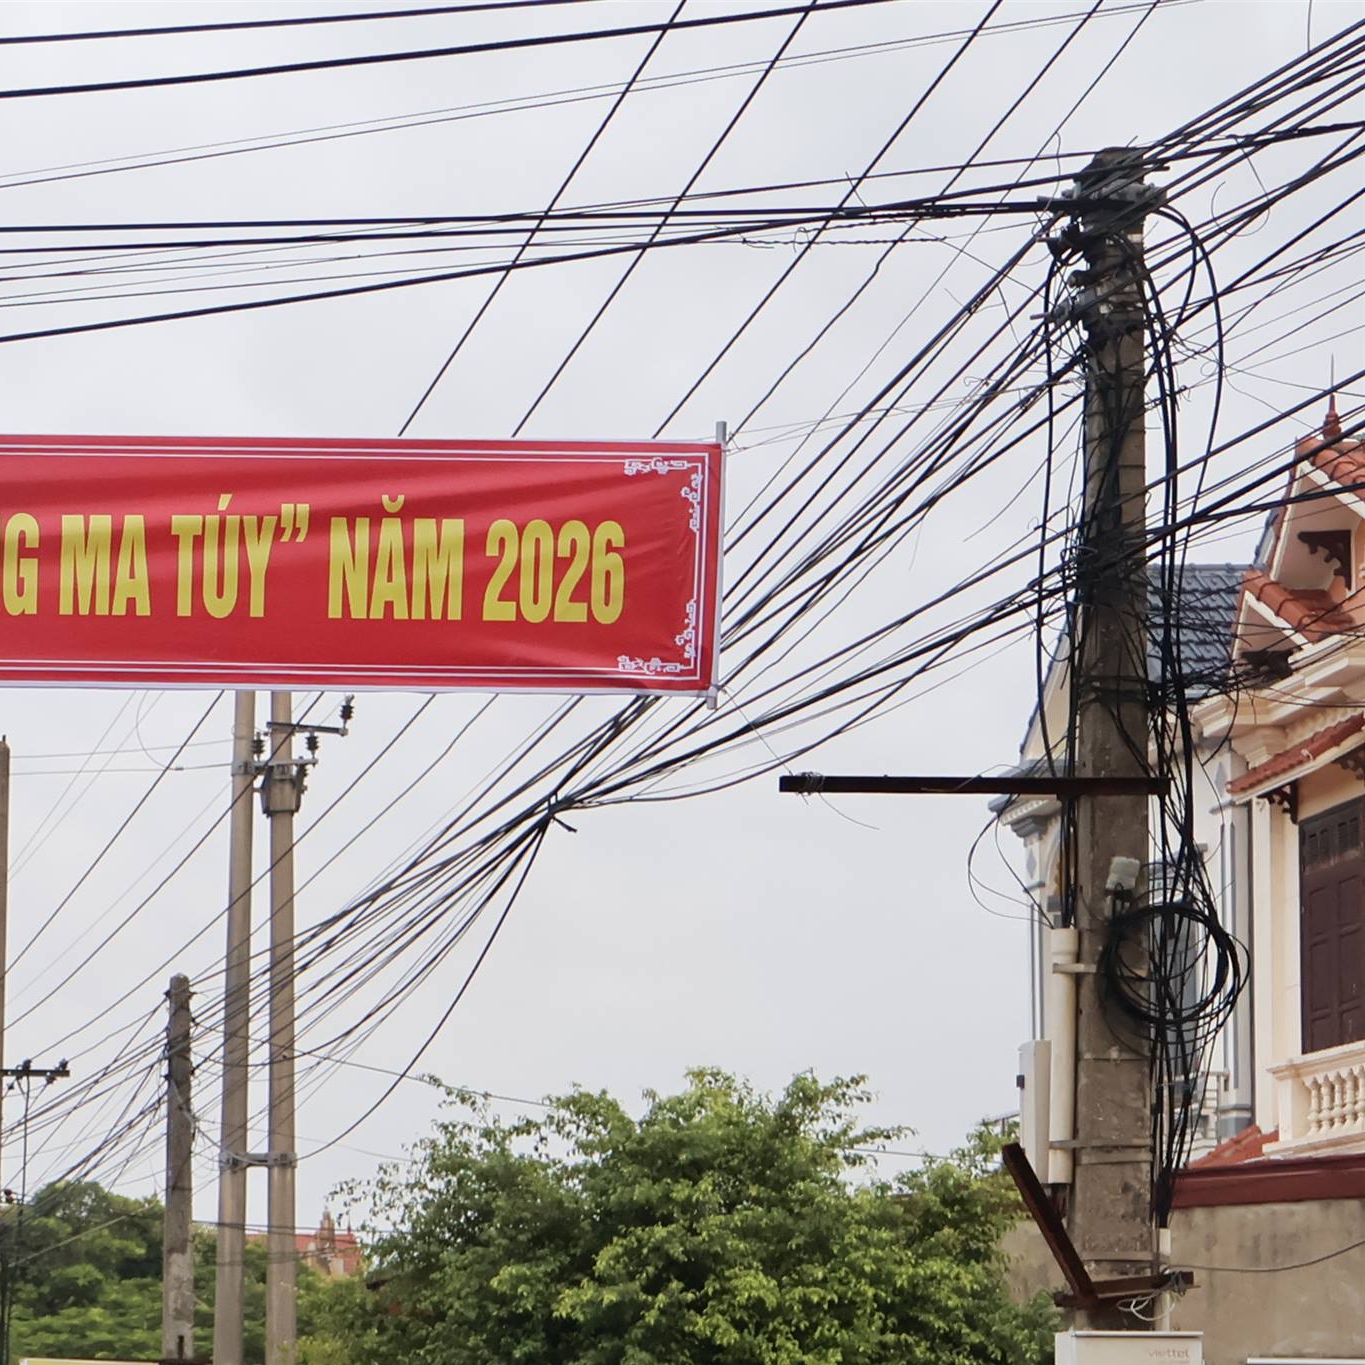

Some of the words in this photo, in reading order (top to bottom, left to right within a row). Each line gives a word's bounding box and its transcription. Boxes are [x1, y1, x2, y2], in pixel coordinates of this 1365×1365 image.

[59, 514, 151, 616] MA
[328, 495, 465, 621] NĂM
[482, 520, 625, 624] 2026
[1149, 1349, 1189, 1358] viettel
